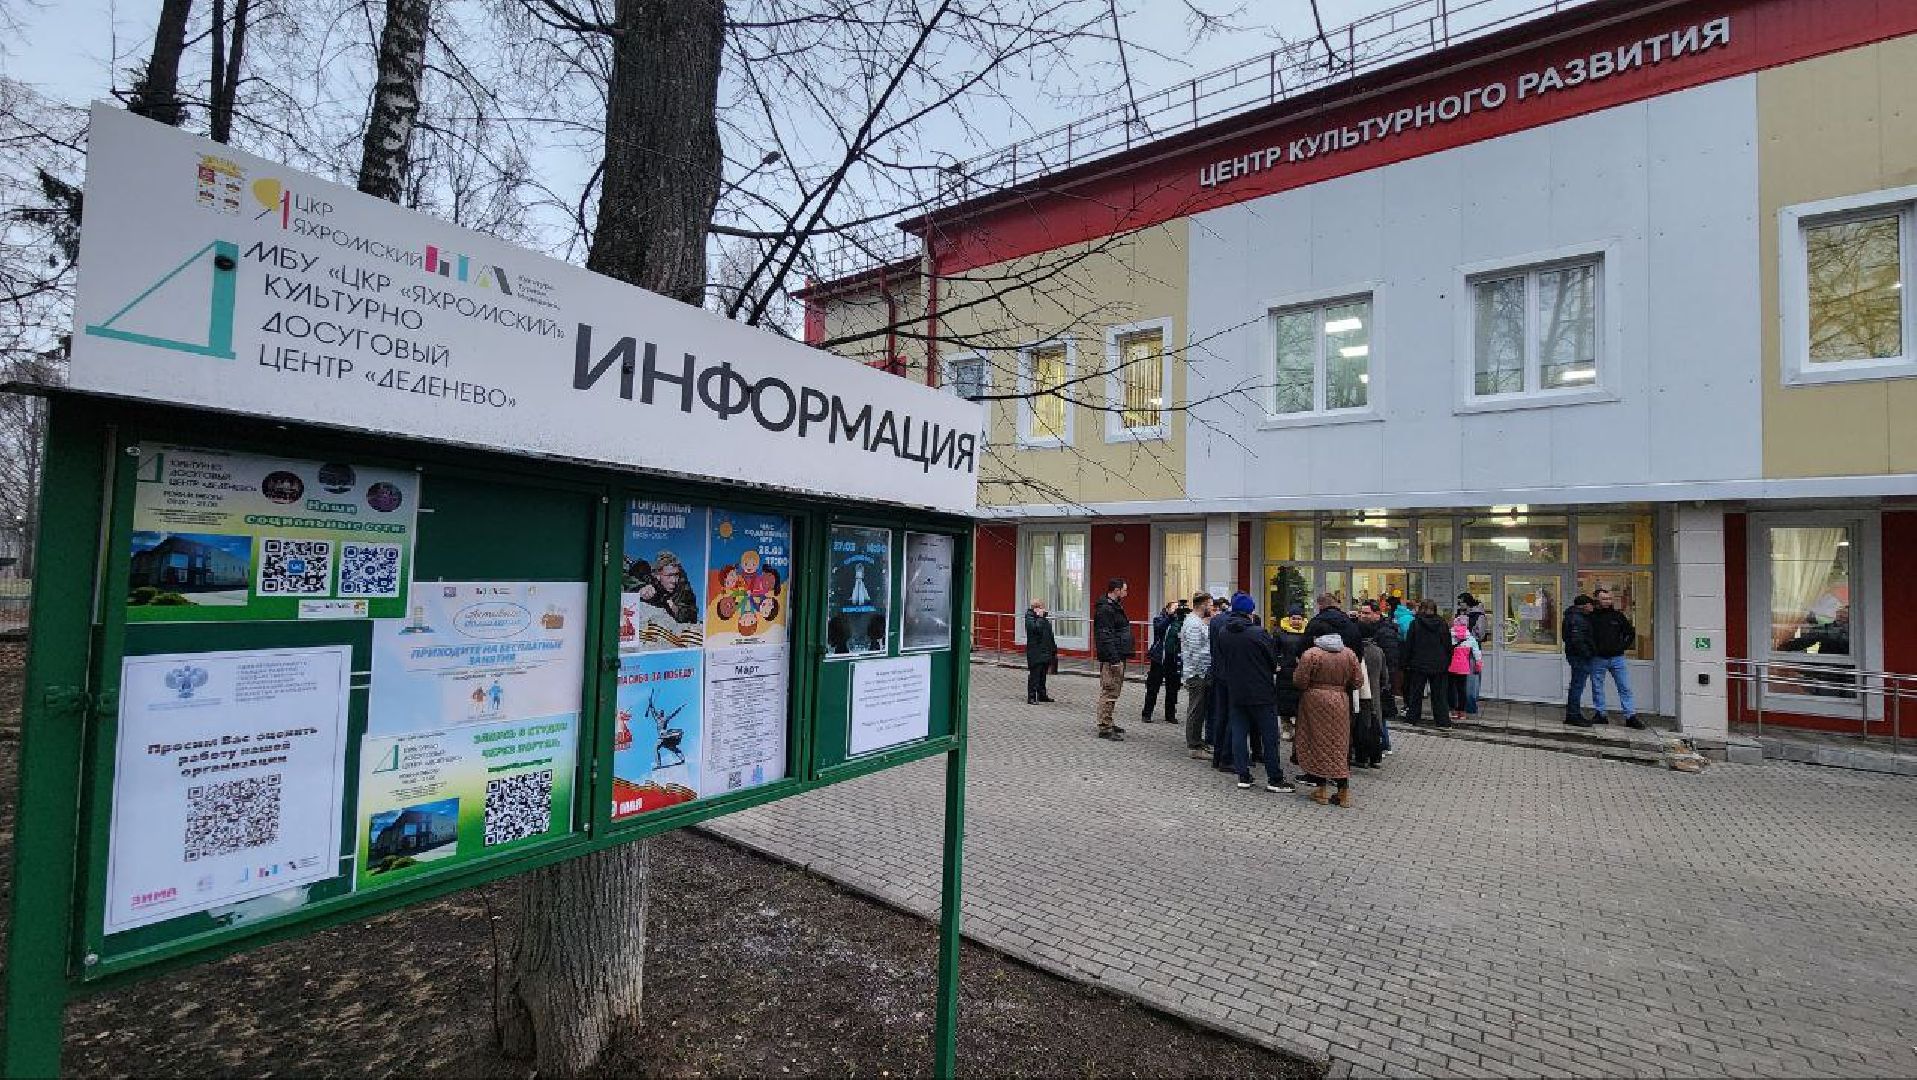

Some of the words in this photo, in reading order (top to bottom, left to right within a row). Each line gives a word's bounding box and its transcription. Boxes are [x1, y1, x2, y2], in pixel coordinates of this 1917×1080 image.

[1199, 146, 1282, 188] ЦЕНТР
[1288, 82, 1507, 160] КУЛЬТУРНОГО
[1516, 16, 1732, 99] РАЗВИТИЯ
[294, 193, 334, 217] ЦКР
[293, 217, 424, 269] ЯХРОМСКИЙ
[244, 241, 320, 273] МБУ
[327, 263, 391, 295] «ЦКР
[400, 284, 566, 340] «ЯХРОМСКИЙ»
[264, 272, 423, 330] КУЛЬТУРНО
[260, 311, 450, 368] ДОСУГОВЫЙ
[258, 343, 354, 379] ЦЕНТР
[365, 367, 517, 408] «ДЕДЕНЕВО»
[573, 322, 975, 473] ИНФОРМАЦИЯ
[306, 500, 357, 515] Наши
[618, 673, 649, 686] ПАСИБО
[735, 665, 759, 675] Март
[148, 740, 218, 756] Просим
[220, 736, 250, 745] Вас
[256, 727, 318, 742] оценить
[178, 751, 236, 767] работу
